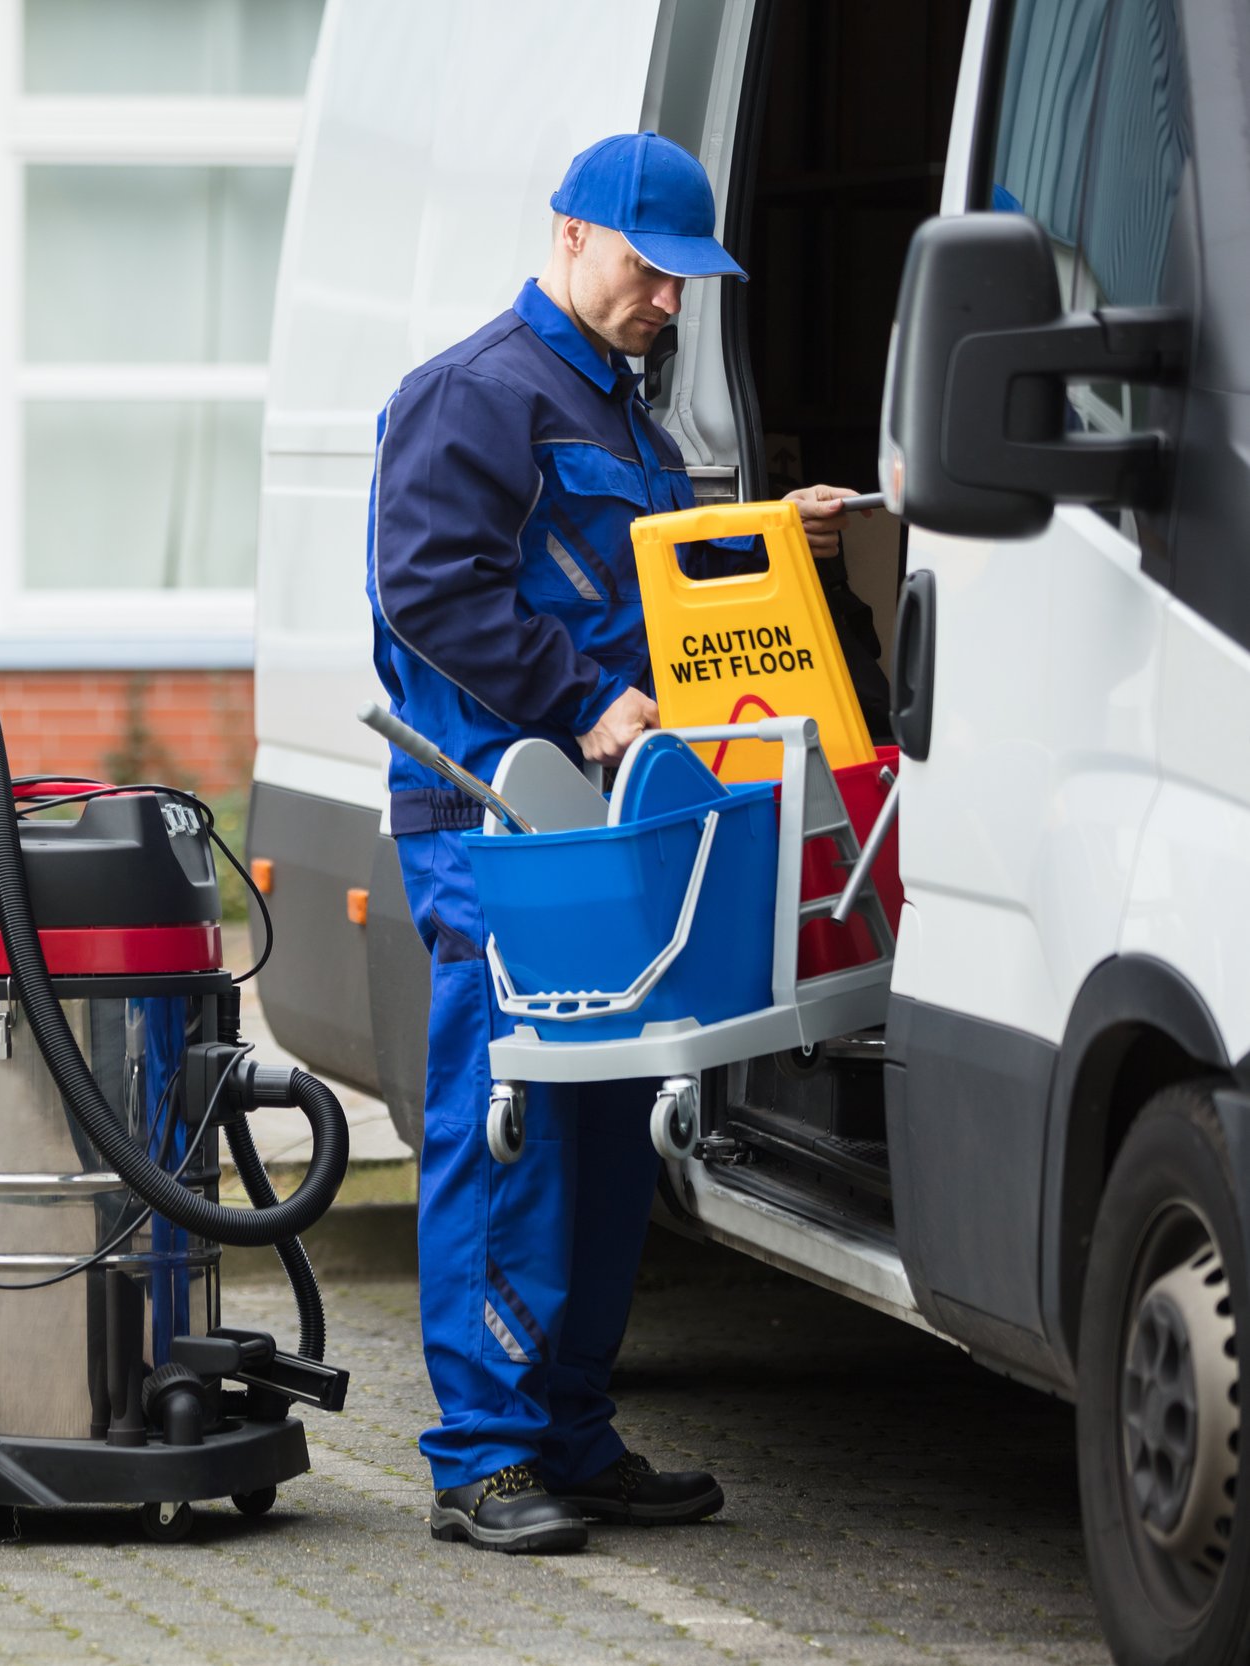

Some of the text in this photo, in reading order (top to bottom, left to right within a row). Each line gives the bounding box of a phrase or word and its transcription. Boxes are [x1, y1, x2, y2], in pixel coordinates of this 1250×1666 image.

[682, 625, 792, 657] CAUTION
[670, 649, 814, 684] WET FLOOR
